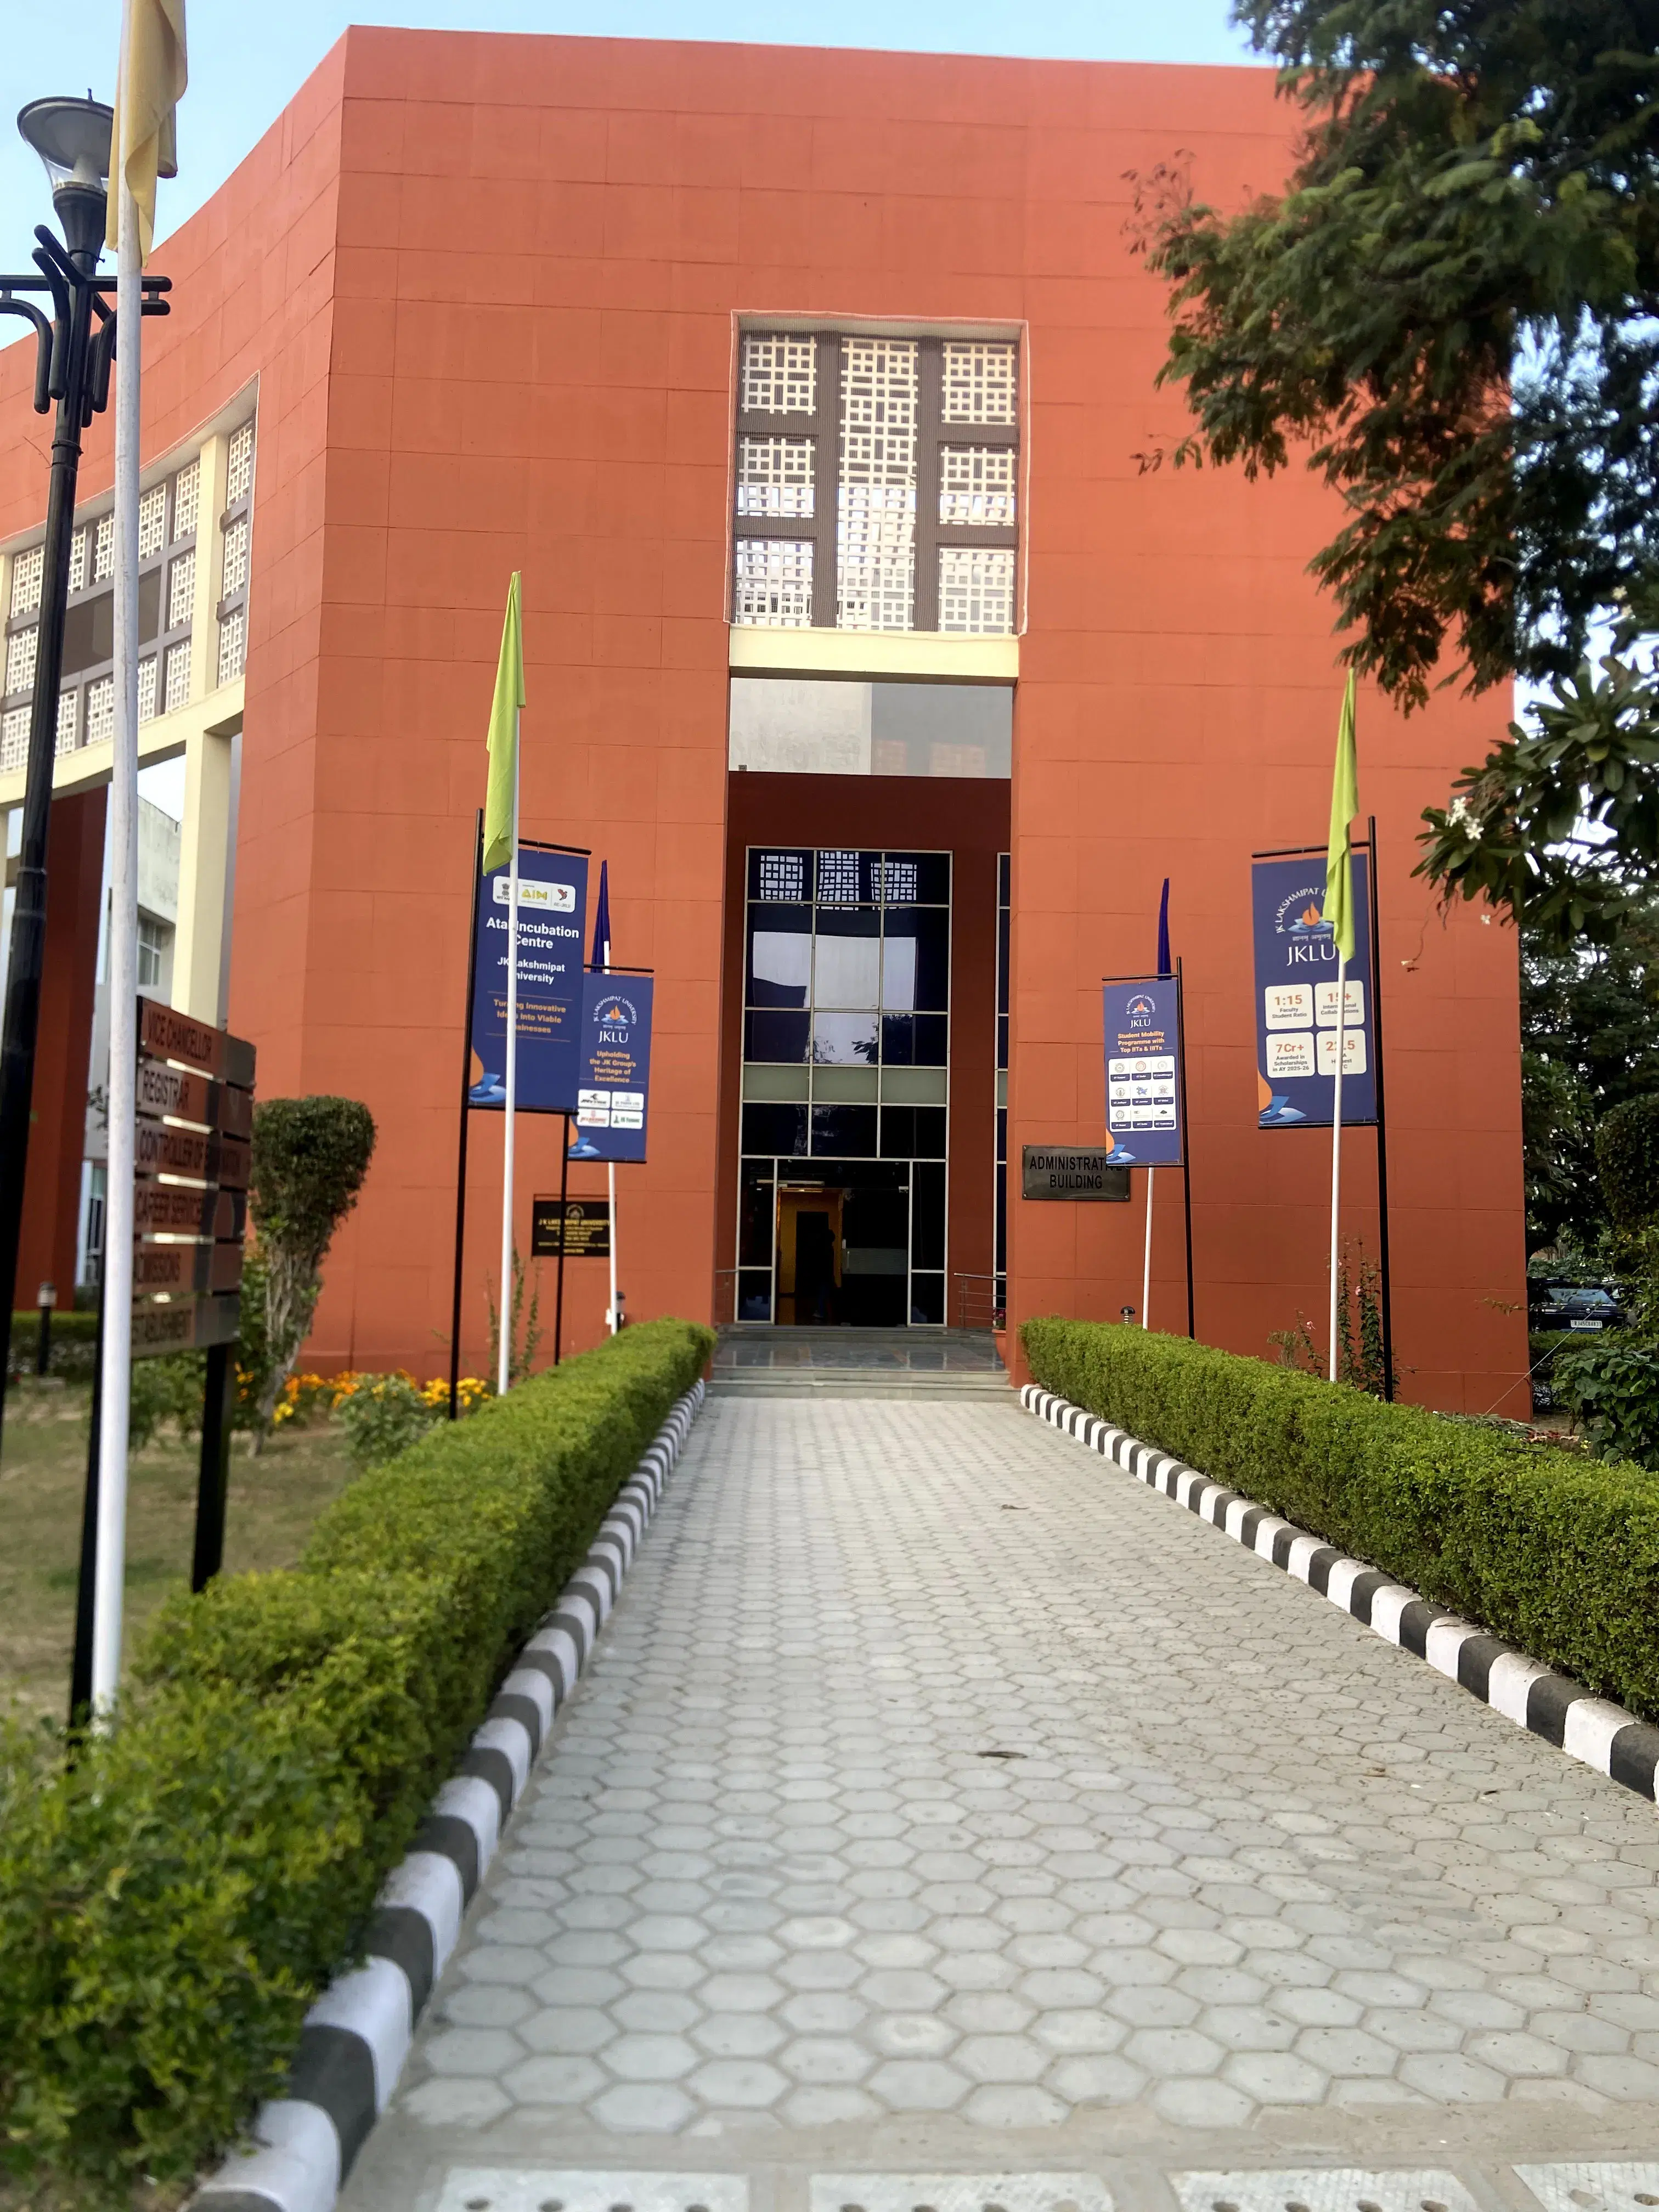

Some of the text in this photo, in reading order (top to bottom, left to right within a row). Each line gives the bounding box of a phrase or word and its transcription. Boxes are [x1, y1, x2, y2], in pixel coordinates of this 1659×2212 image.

[1275, 887, 1319, 923] LAKSHMIPAT
[486, 917, 579, 938] Ata Incubation
[516, 934, 553, 949] Centre
[1286, 944, 1336, 966] JKLU
[516, 959, 565, 973] akshmipat
[516, 971, 554, 985] niversity
[1274, 994, 1302, 1006] 1:15
[1130, 1018, 1151, 1029] JKLU
[598, 1031, 629, 1043] JKLU
[1030, 1156, 1122, 1171] ADMINISTRAT
[1049, 1175, 1102, 1189] BUILDING
